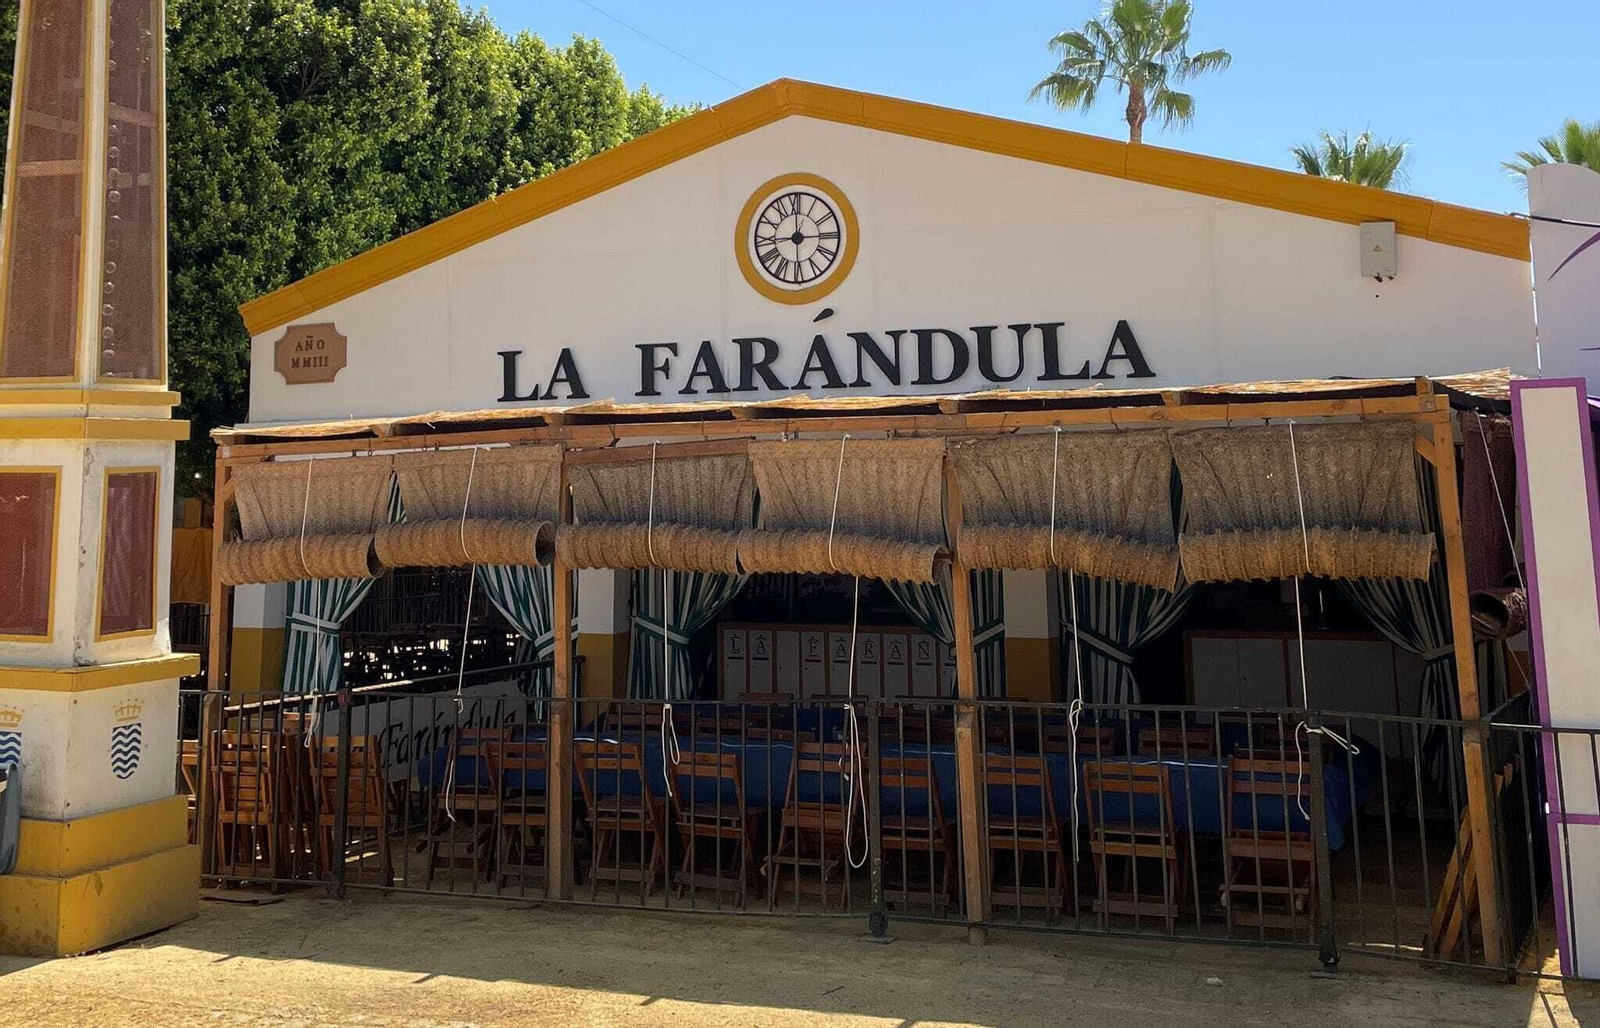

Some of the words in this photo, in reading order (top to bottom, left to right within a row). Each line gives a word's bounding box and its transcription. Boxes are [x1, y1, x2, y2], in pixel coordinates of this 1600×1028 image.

[295, 334, 325, 352] AÑO
[291, 356, 329, 369] MMIII
[497, 349, 589, 402] LA
[634, 307, 1157, 396] FARÁNDULA
[808, 641, 931, 658] FARAN
